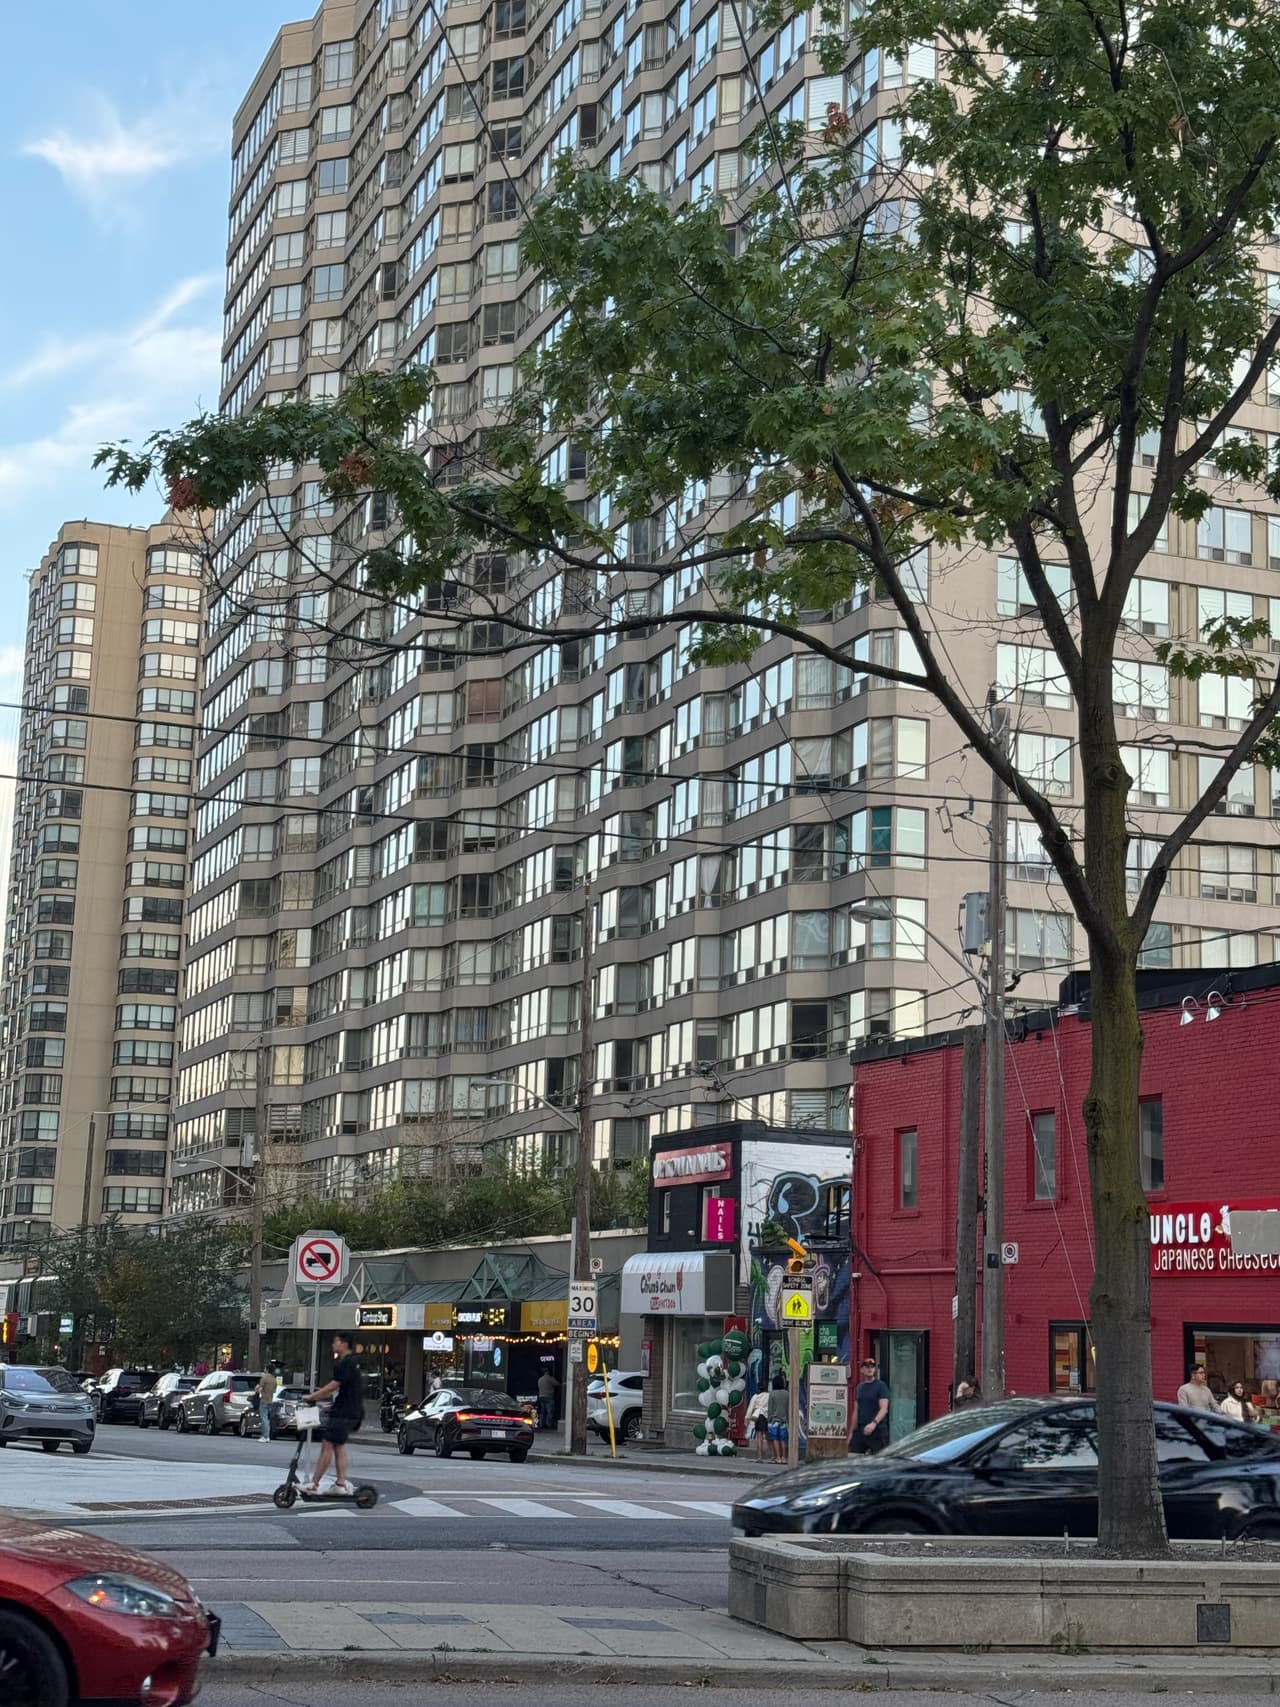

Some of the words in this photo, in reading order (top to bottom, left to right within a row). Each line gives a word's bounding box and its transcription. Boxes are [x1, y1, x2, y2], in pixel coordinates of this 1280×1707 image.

[717, 1199, 725, 1240] NAILS
[571, 1296, 594, 1313] 30
[571, 1319, 593, 1328] AREA
[568, 1330, 595, 1338] BEGINS
